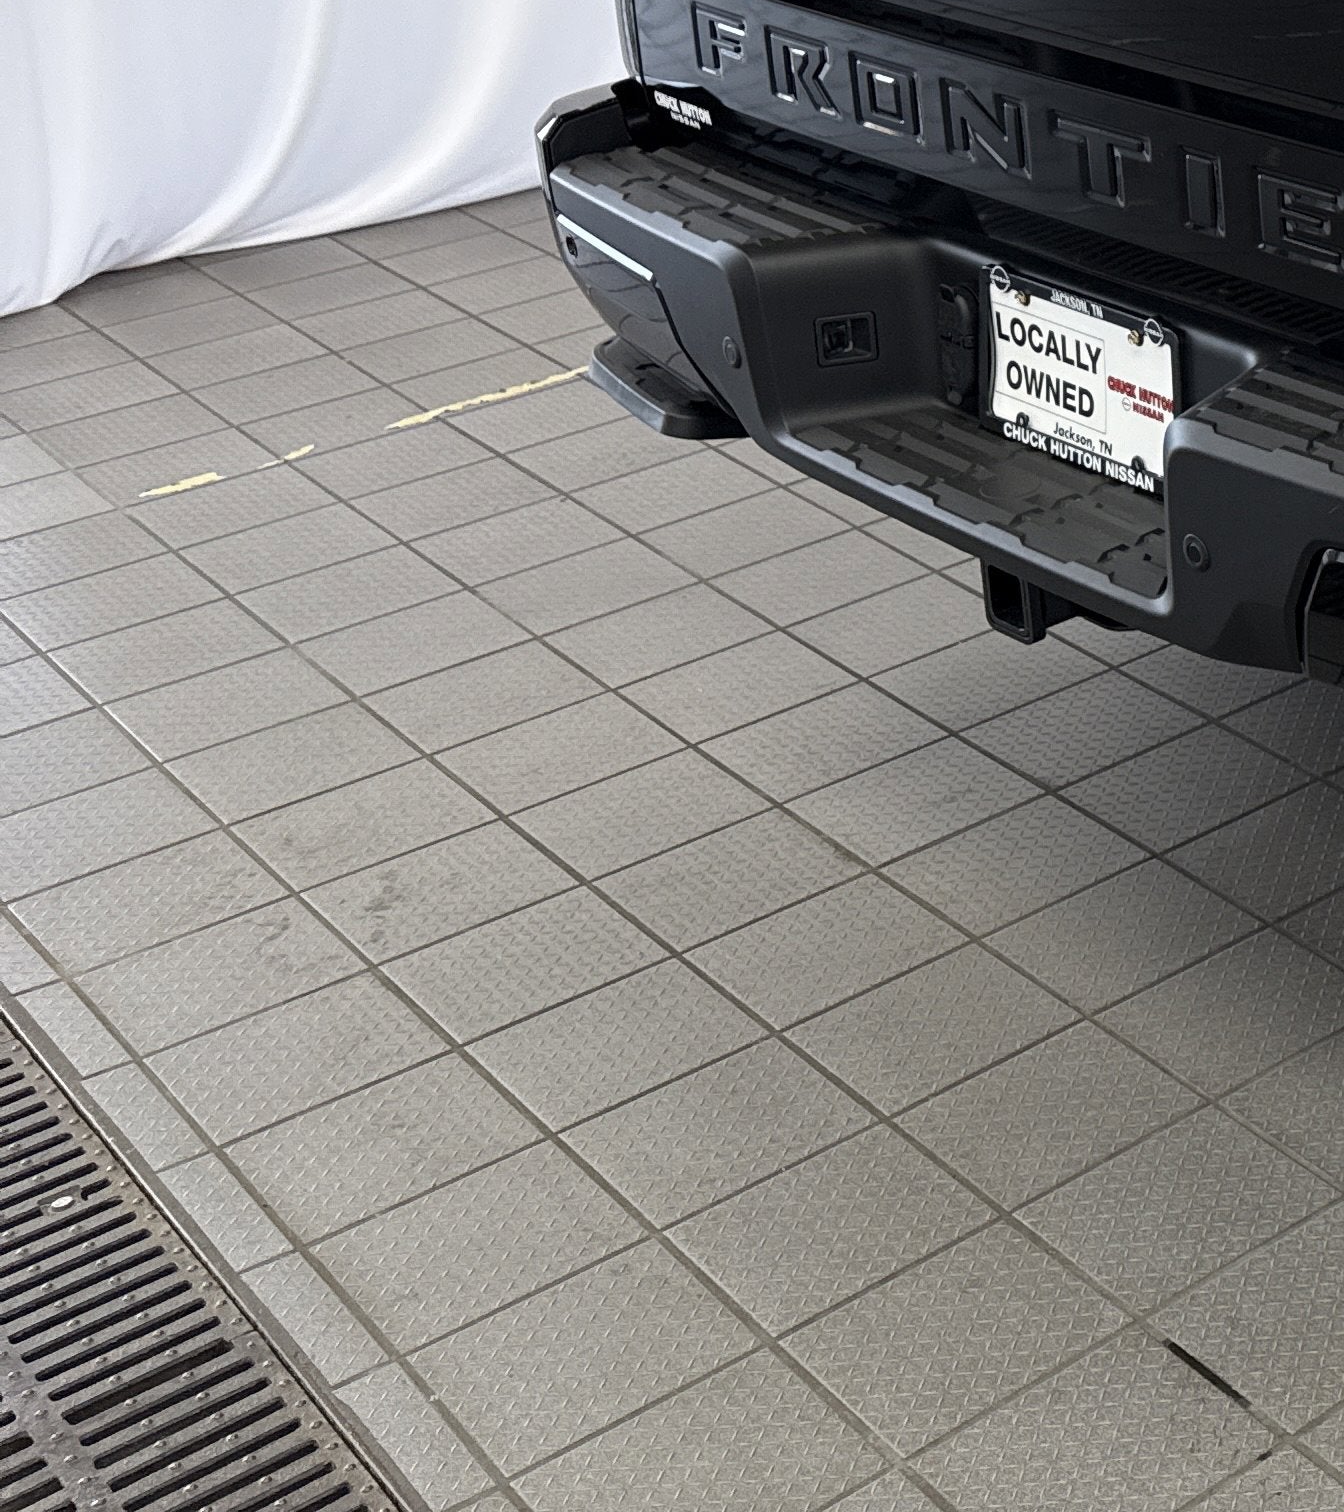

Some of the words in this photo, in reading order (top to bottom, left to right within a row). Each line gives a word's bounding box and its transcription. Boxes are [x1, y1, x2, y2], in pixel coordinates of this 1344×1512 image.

[1091, 302, 1104, 319] TN
[995, 310, 1102, 375] LOCALLY
[1005, 360, 1095, 419] OWNED
[1003, 421, 1047, 452] CHUCK
[1050, 438, 1102, 473] HUTTON
[1105, 459, 1155, 493] NISSAN
[1053, 422, 1096, 451] Jackson,
[1099, 438, 1113, 457] TN
